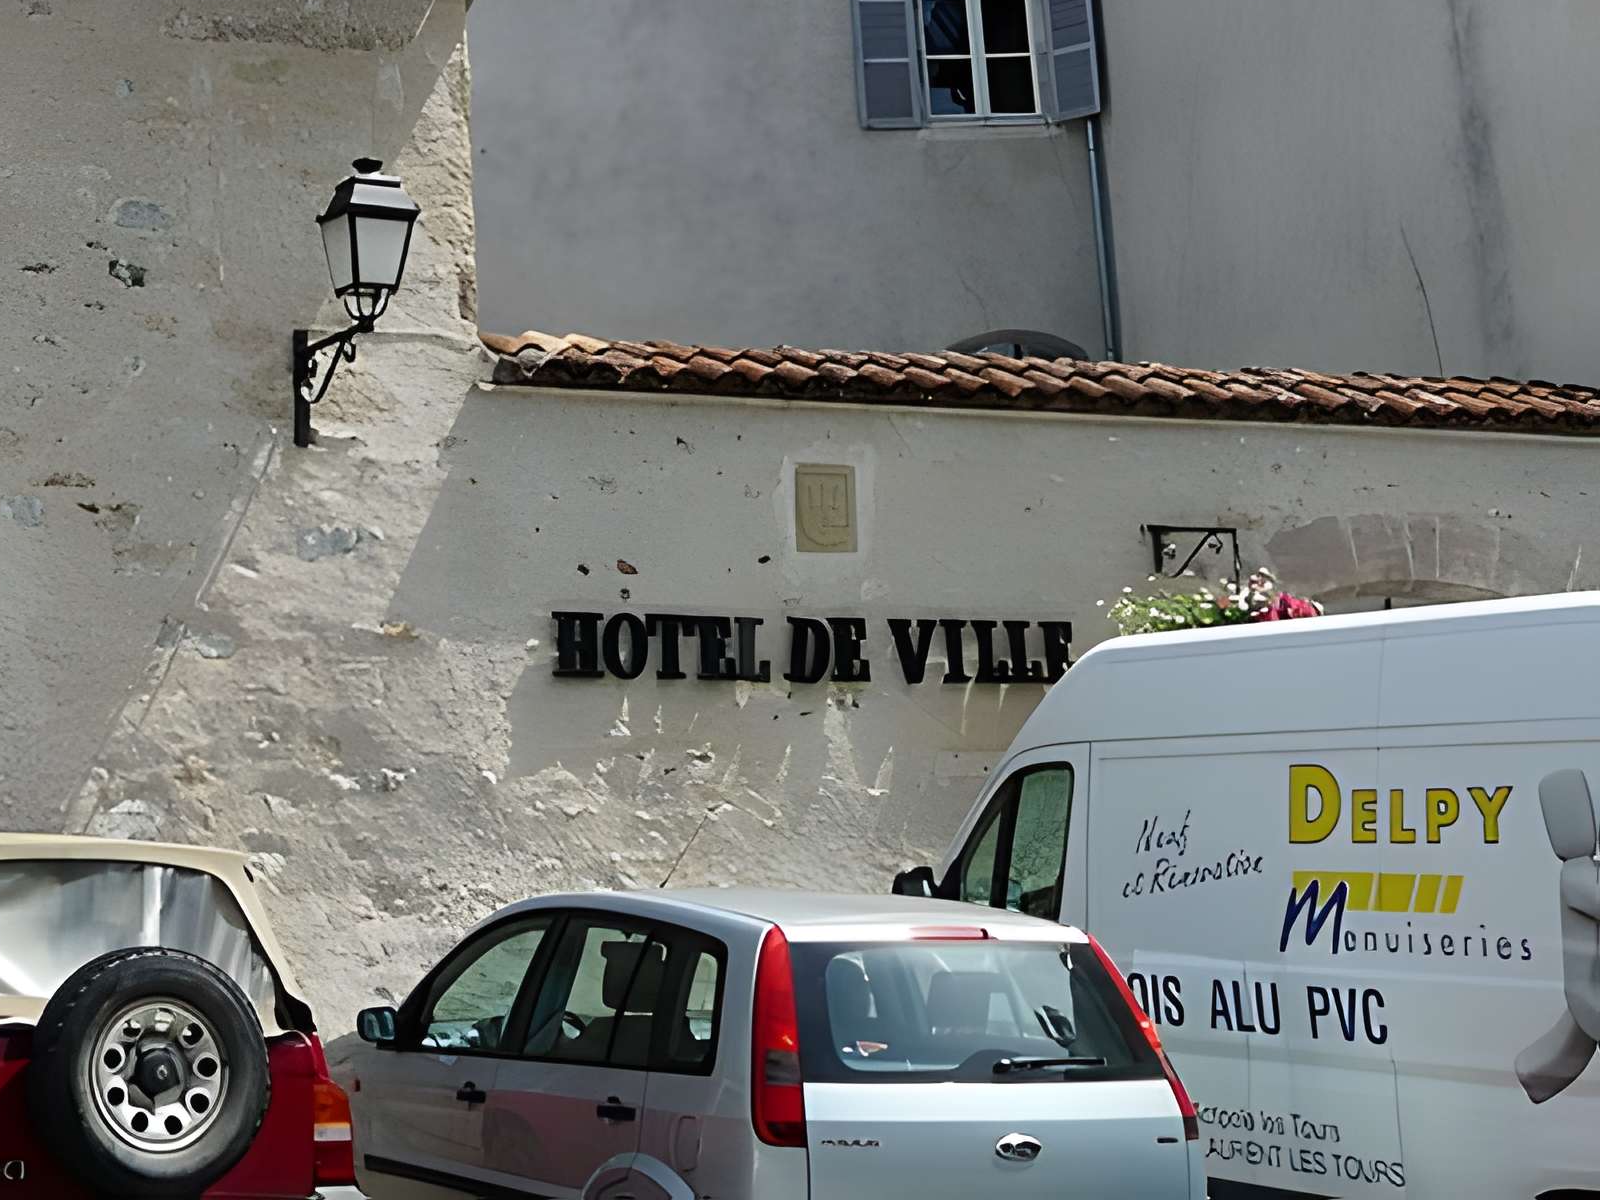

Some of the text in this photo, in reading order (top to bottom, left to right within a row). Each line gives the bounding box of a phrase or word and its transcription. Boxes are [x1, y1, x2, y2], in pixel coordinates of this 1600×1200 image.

[551, 611, 1073, 685] HOTEL DE VILLE
[1288, 763, 1514, 844] DELPY
[1126, 972, 1388, 1046] OIS ALU PVC
